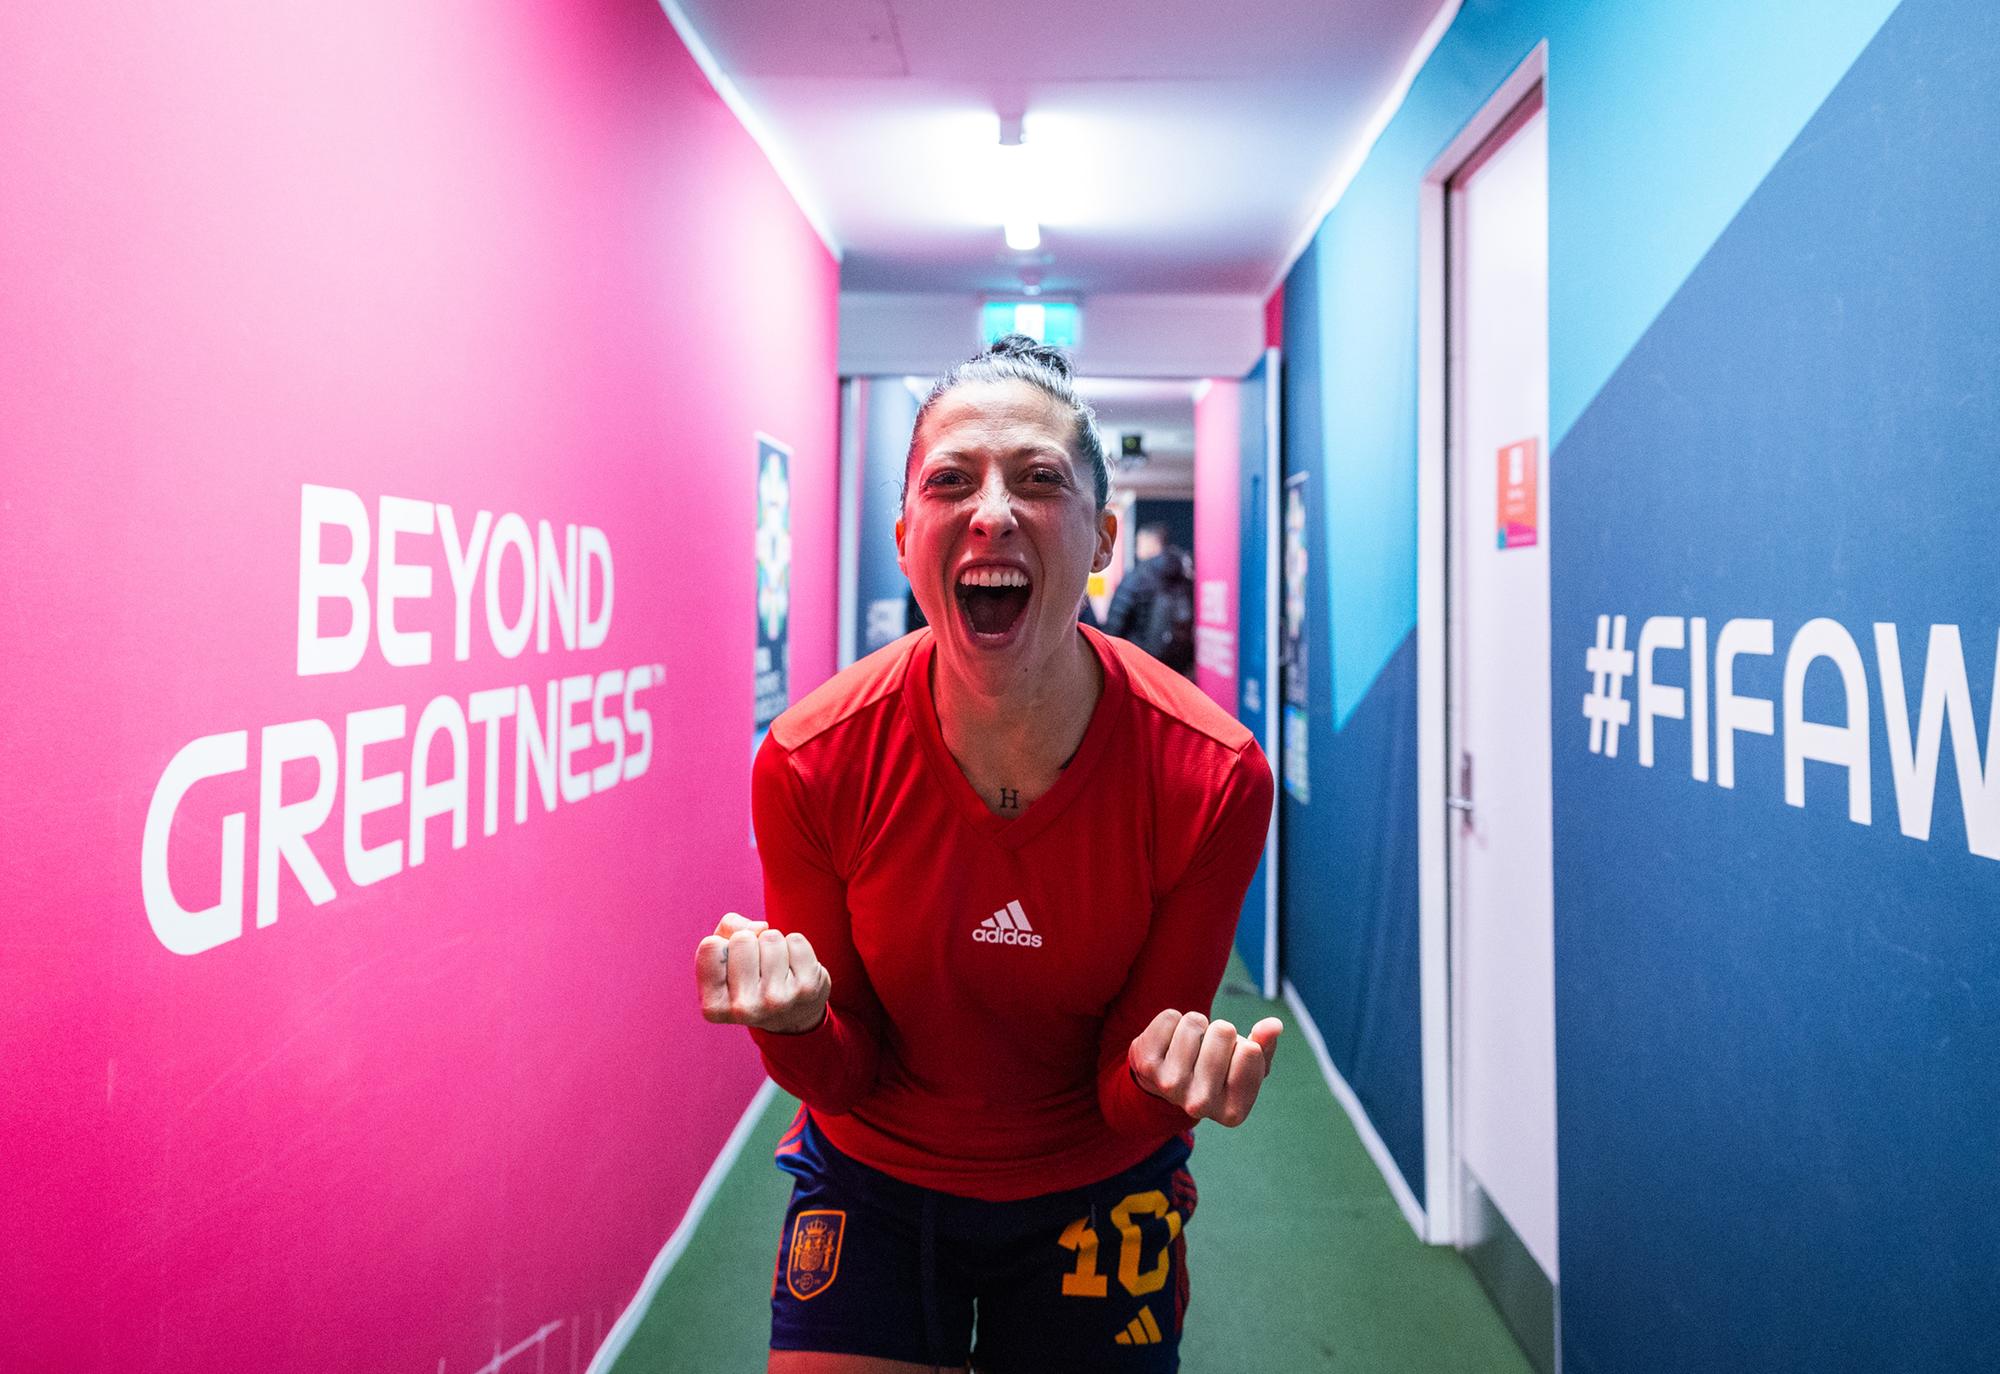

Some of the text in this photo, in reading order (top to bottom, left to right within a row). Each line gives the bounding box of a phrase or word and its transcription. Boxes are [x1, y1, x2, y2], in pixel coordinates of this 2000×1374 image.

[297, 483, 615, 676] BEYOND
[1582, 614, 2000, 862] #FIFAW
[1000, 788, 1020, 809] H
[972, 927, 1043, 948] adidas
[1057, 1189, 1182, 1297] 10
